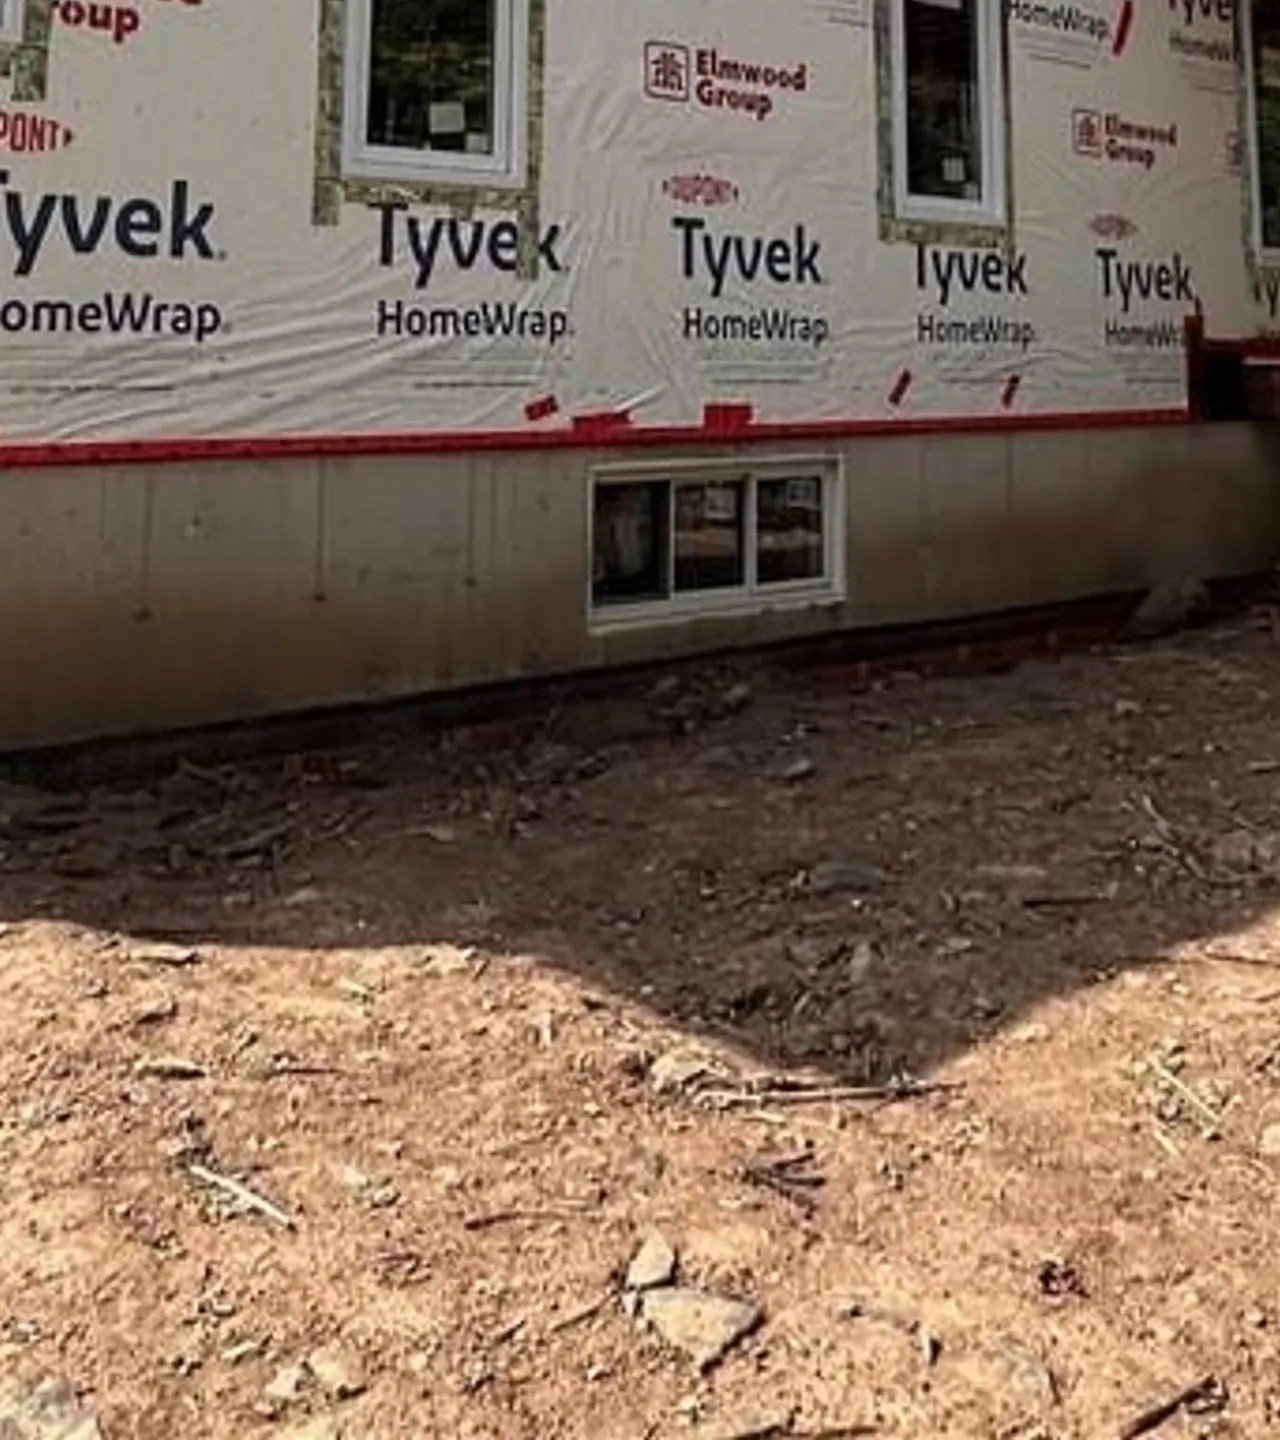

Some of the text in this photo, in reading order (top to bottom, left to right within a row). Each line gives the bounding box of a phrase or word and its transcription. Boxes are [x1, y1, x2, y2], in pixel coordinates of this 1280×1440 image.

[53, 0, 139, 44] oup
[696, 49, 807, 92] Elmwood
[695, 80, 773, 121] Group
[673, 217, 823, 298] Tyvek
[1096, 247, 1194, 312] Tyvek
[377, 300, 568, 345] HomeWrap
[683, 308, 829, 347] HomeWrap
